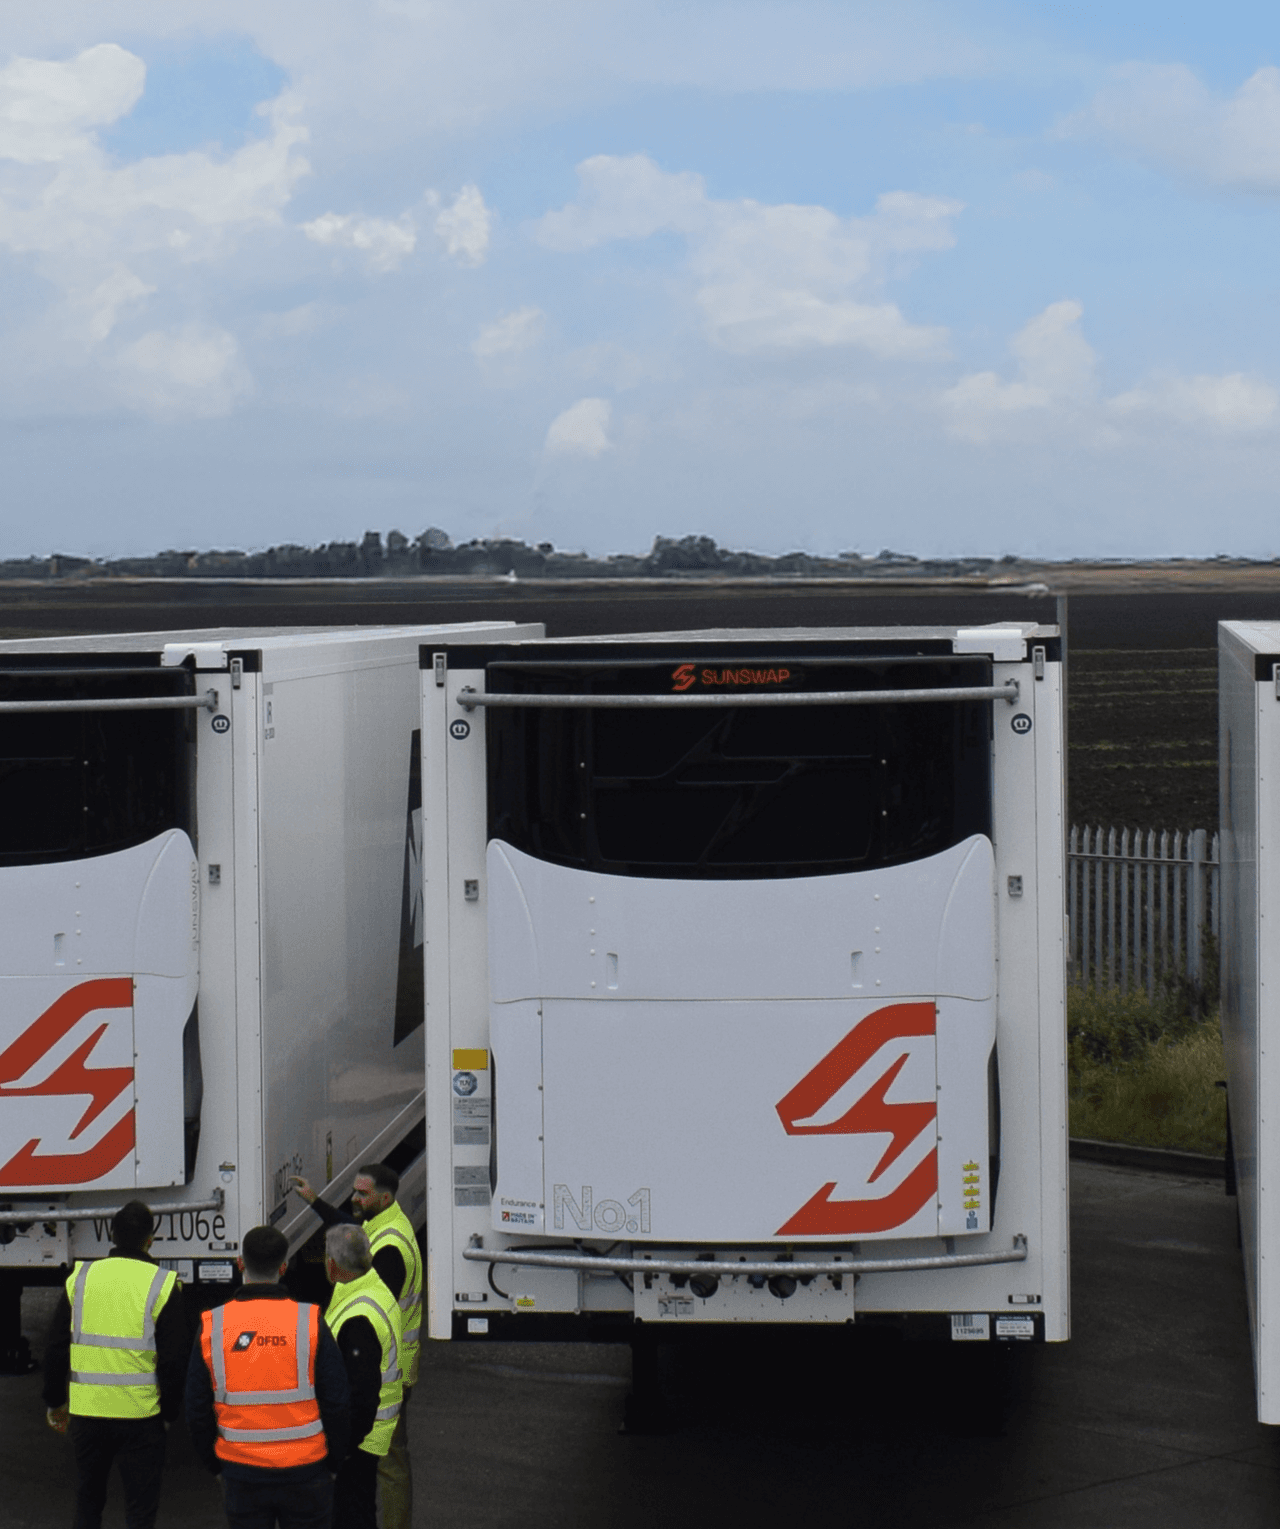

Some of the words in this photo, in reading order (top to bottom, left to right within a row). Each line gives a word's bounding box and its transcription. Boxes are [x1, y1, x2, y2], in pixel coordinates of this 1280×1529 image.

[702, 669, 790, 685] SUNSWAP
[501, 1197, 537, 1208] Endurance
[94, 1211, 226, 1242] W2106e
[256, 1336, 287, 1346] DFDS
